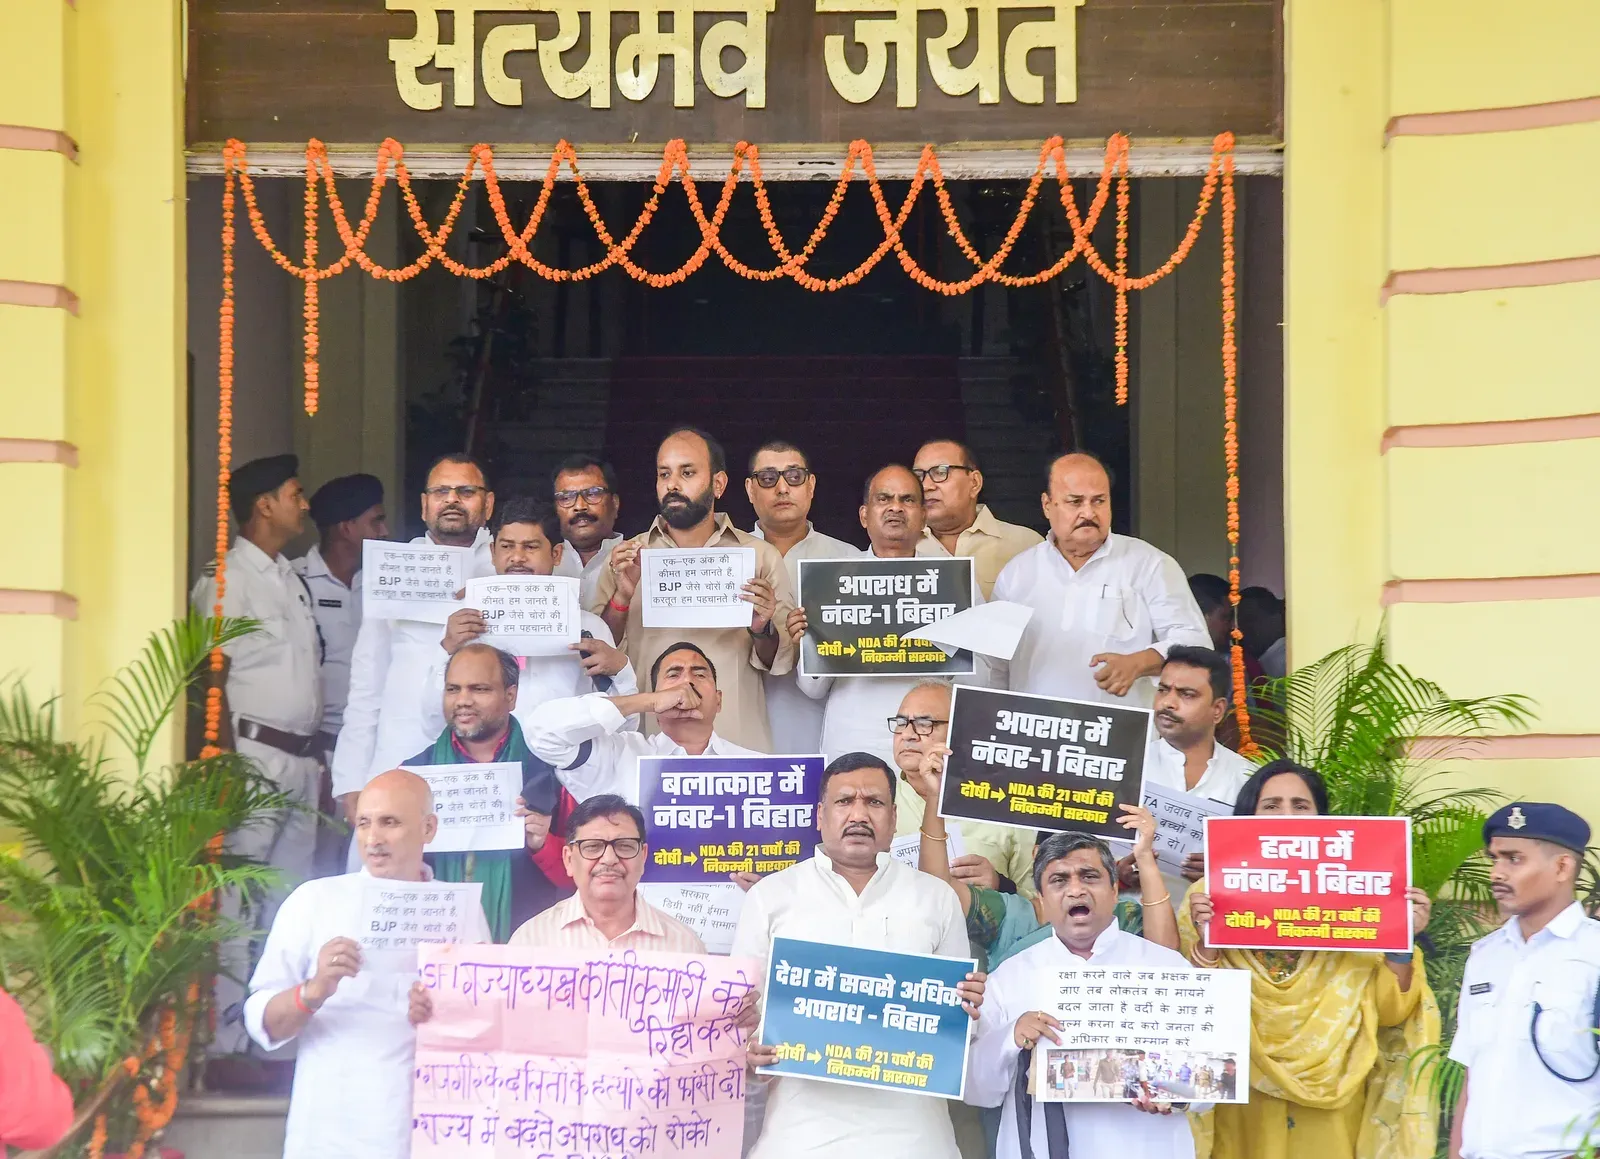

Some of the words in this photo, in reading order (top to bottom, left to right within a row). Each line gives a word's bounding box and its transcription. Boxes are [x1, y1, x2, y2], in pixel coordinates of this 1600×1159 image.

[385, 0, 776, 111] सत्यमव
[815, 0, 1086, 109] जयत
[439, 552, 450, 561] की
[700, 556, 714, 564] अंक
[719, 554, 729, 564] की
[420, 565, 441, 574] जानते
[659, 568, 680, 578] कीमत
[685, 568, 696, 577] हम
[701, 567, 722, 576] जानते
[379, 577, 401, 585] BJP
[444, 579, 454, 588] की
[525, 583, 539, 593] अंक
[545, 584, 555, 593] की
[659, 582, 682, 591] BJP
[686, 581, 700, 590] जैसे
[726, 581, 735, 590] की
[839, 574, 912, 596] अपराध
[916, 569, 939, 595] में
[482, 596, 504, 605] कीमत
[525, 596, 547, 605] जानते
[653, 596, 677, 606] करतूत
[682, 596, 692, 604] हम
[696, 594, 728, 604] पहचानते
[482, 610, 505, 619] BJP
[509, 609, 524, 619] जैसे
[550, 611, 560, 619] की
[821, 599, 891, 625] नंबर-1
[896, 598, 955, 624] बिहार
[520, 623, 553, 632] पहचानते
[858, 637, 881, 648] NDA
[883, 634, 898, 648] की
[817, 641, 842, 656] दोषी
[861, 649, 906, 663] निकम्मी
[908, 652, 946, 662] सरकार
[996, 710, 1081, 743] अपराध
[1084, 716, 1113, 746] में
[971, 735, 1051, 772] नंबर-1
[1057, 744, 1126, 781] बिहार
[464, 773, 479, 781] अंक
[484, 771, 495, 780] की
[661, 772, 773, 796] बलात्कार
[778, 764, 806, 795] में
[447, 789, 459, 797] हम
[464, 785, 488, 795] जानते
[960, 780, 990, 800] दोषी
[1009, 783, 1035, 796] NDA
[1037, 783, 1055, 800] की
[1056, 789, 1070, 802] 21
[1095, 791, 1115, 808] की
[491, 799, 502, 809] की
[1010, 798, 1063, 818] निकम्मी
[1064, 807, 1108, 824] सरकार
[443, 817, 455, 825] हम
[460, 814, 494, 823] पहचानते
[653, 798, 736, 829] नंबर-1
[742, 798, 813, 828] बिहार
[700, 845, 725, 857] NDA
[727, 841, 744, 856] की
[746, 845, 758, 856] 21
[785, 840, 800, 855] की
[1258, 835, 1320, 859] हत्या
[1324, 829, 1354, 860] में
[654, 848, 682, 865] दोषी
[703, 858, 753, 873] निकम्मी
[1222, 861, 1310, 894] नंबर-1
[1315, 863, 1393, 896] बिहार
[444, 891, 455, 901] की
[403, 908, 416, 916] हम
[1273, 909, 1301, 921] NDA
[1303, 906, 1321, 922] की
[1322, 910, 1336, 922] 21
[1363, 907, 1381, 923] की
[371, 921, 396, 932] BJP
[446, 922, 456, 932] की
[1225, 911, 1256, 928] दोषी
[1277, 924, 1331, 939] निकम्मी
[1332, 927, 1378, 940] सरकार
[424, 963, 457, 989] SFI
[1083, 969, 1106, 979] करने
[1112, 970, 1132, 979] वाले
[1138, 972, 1155, 980] जब
[1161, 973, 1190, 981] भक्षक
[776, 960, 811, 988] देश
[814, 965, 838, 990] में
[840, 973, 896, 999] सबसे
[900, 977, 963, 1007] अधिक
[1109, 984, 1148, 995] लोकतंत्र
[1155, 988, 1168, 996] का
[1175, 987, 1205, 997] मायने
[1058, 1003, 1082, 1011] बदल
[1089, 1003, 1114, 1011] जाता
[1121, 1001, 1127, 1013] है
[1160, 1003, 1170, 1013] के
[1204, 1004, 1214, 1015] में
[793, 997, 864, 1024] अपराध
[882, 1002, 940, 1034] बिहार
[1088, 1020, 1114, 1028] करना
[1121, 1019, 1135, 1029] बंद
[1141, 1020, 1159, 1030] करो
[1166, 1023, 1194, 1031] जनता
[1201, 1022, 1214, 1032] की
[1071, 1033, 1110, 1044] अधिकार
[1134, 1037, 1169, 1045] सम्मान
[825, 1044, 852, 1060] NDA
[856, 1045, 872, 1062] की
[875, 1051, 888, 1064] 21
[916, 1053, 934, 1070] की
[827, 1060, 881, 1081] निकम्मी
[883, 1068, 928, 1088] सरकार
[420, 1113, 474, 1145] राज्य
[629, 1116, 658, 1154] को
